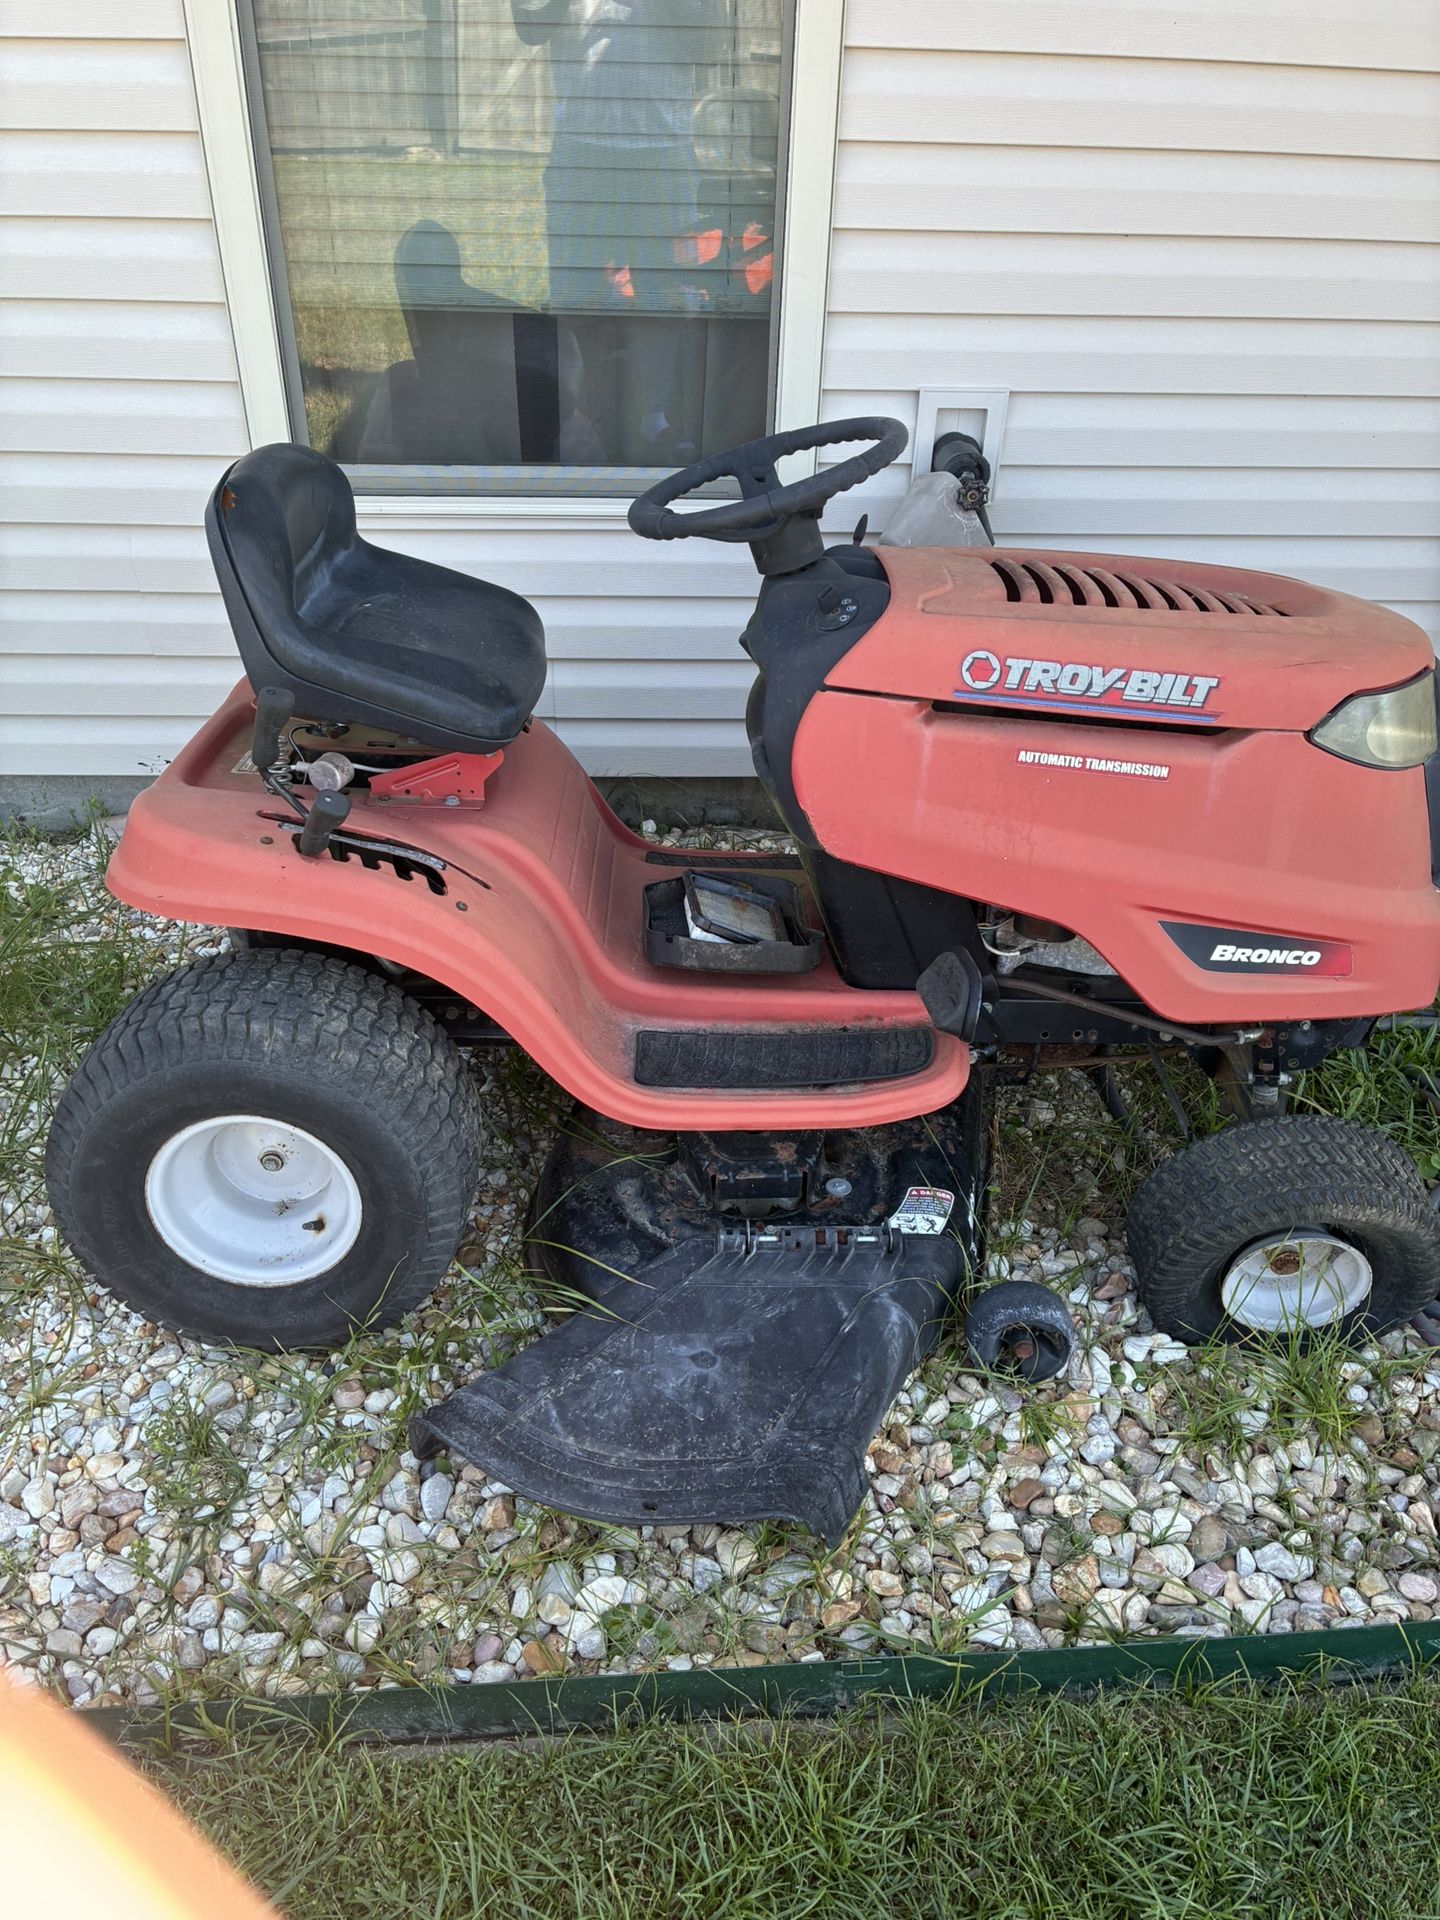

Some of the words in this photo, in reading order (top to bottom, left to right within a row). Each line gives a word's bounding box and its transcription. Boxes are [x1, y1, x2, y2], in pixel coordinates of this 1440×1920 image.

[1004, 657, 1219, 708] TROY-BILT
[1018, 750, 1083, 768] AUTOMATIC
[1085, 757, 1169, 778] TRANSMISSION
